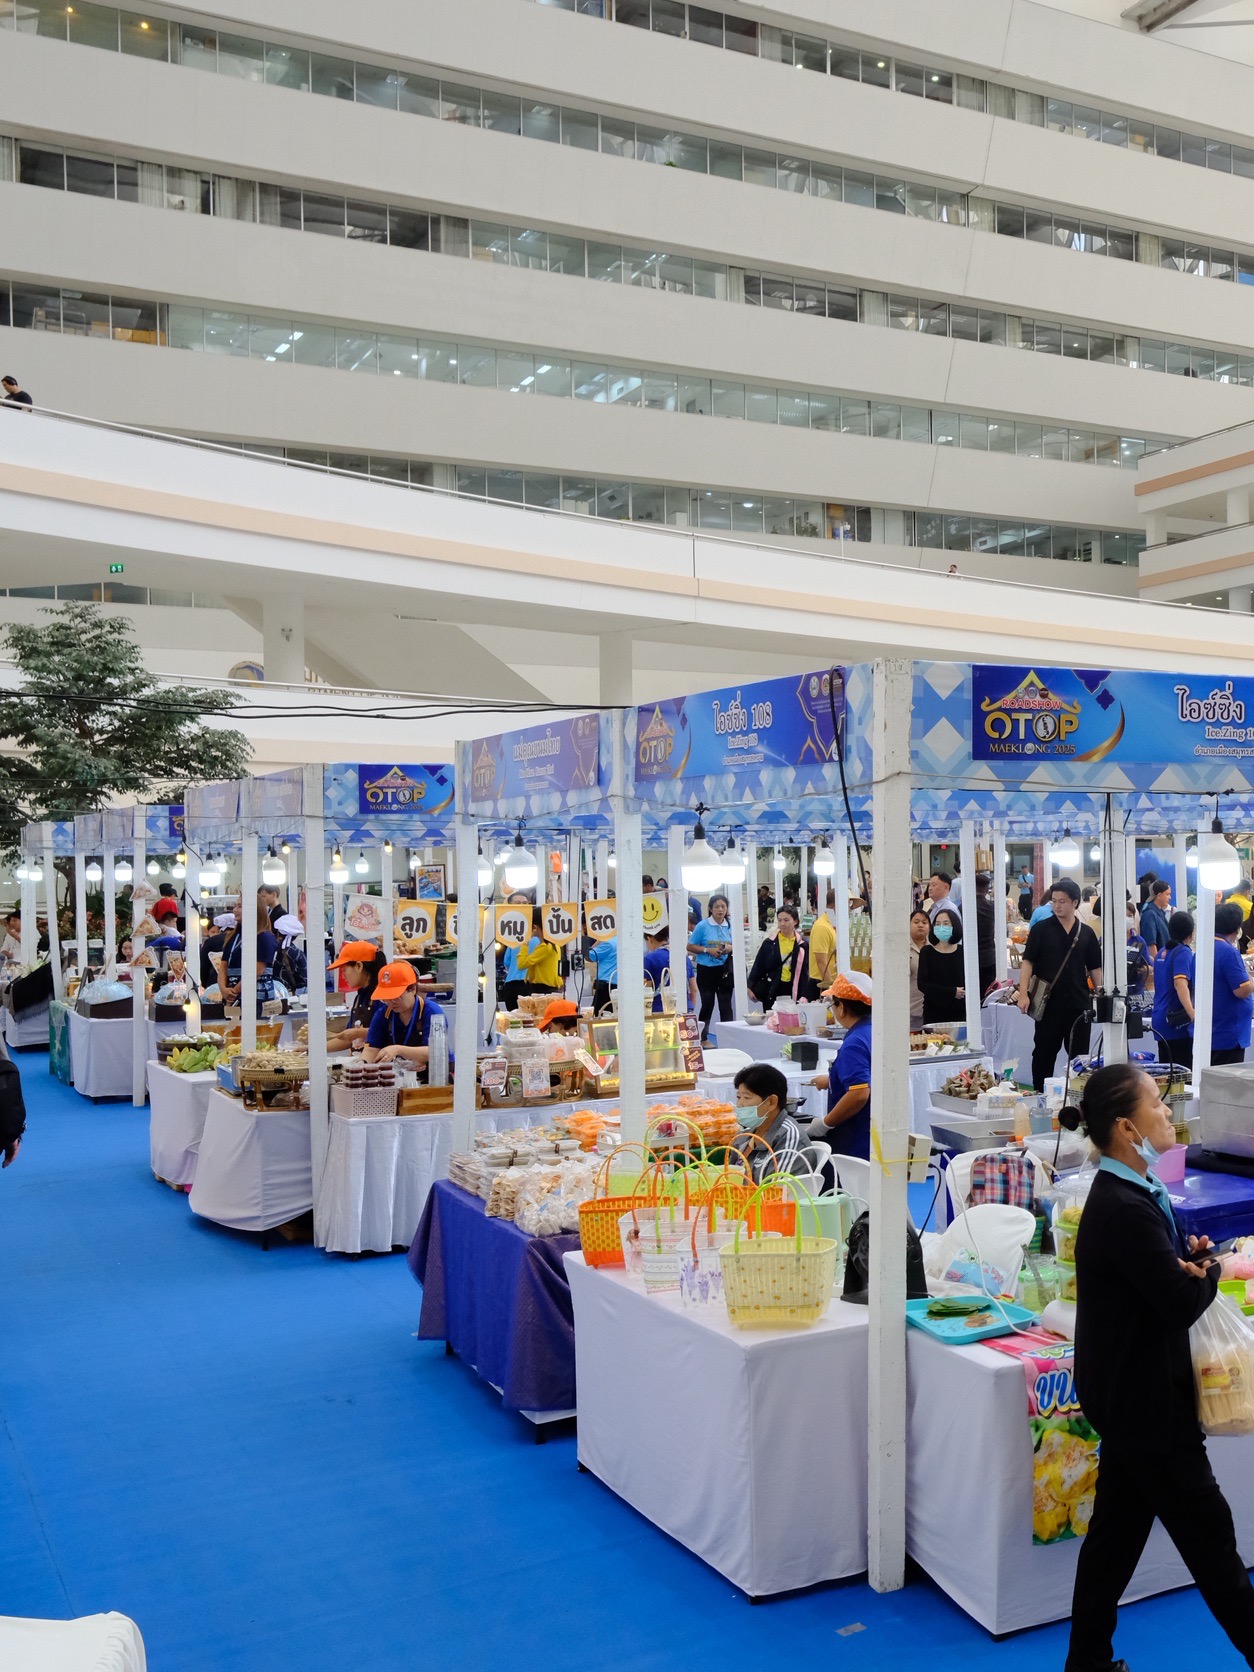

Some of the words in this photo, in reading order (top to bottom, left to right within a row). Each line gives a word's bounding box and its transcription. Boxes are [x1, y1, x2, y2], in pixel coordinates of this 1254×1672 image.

[712, 690, 748, 735] ไอซ์ซิ่ง
[750, 701, 773, 729] 108
[1001, 698, 1061, 711] ROADSHOW
[1174, 681, 1245, 723] ไอซ์ซิ่ง
[984, 711, 1079, 742] OTOP
[639, 735, 675, 764] OTOP
[989, 742, 1051, 755] MAEKLONG
[1053, 743, 1076, 755] 2025
[366, 788, 426, 805] OTOP
[400, 916, 428, 940] ลูก
[500, 918, 526, 942] หมู
[548, 907, 574, 935] ปั้น
[590, 912, 616, 932] สด
